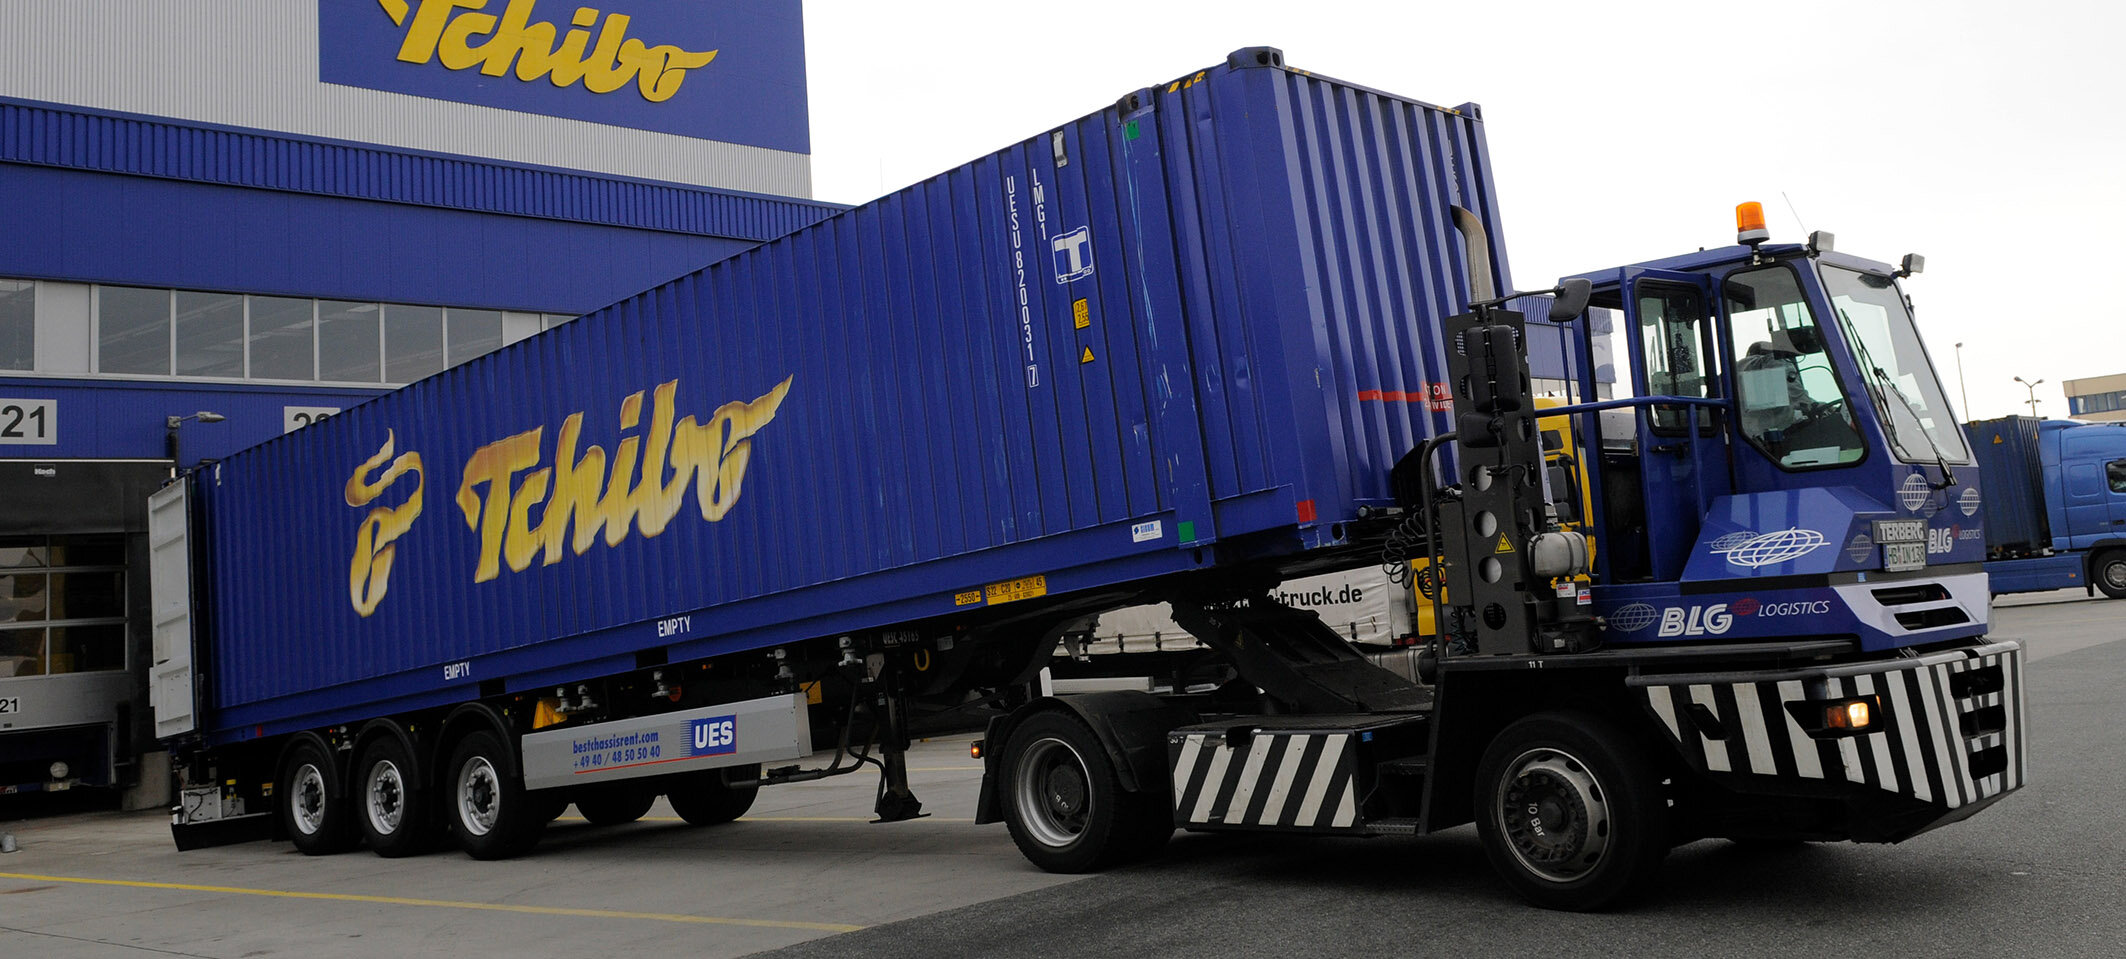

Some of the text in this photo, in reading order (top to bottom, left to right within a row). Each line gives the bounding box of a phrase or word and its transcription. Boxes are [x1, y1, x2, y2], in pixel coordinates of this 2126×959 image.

[378, 0, 718, 103] Tchibo
[1032, 168, 1046, 240] LMG1
[1, 405, 45, 437] 21
[455, 373, 793, 583] Tchibo
[1880, 522, 1924, 540] TERBERG
[1927, 527, 1981, 554] BLG LOGISTICS
[1269, 584, 1363, 606] -truck.de
[658, 615, 691, 637] EMPTY
[1658, 600, 1830, 637] BLG LOGISTICS
[444, 661, 470, 680] EMPTY
[0, 698, 18, 713] 21
[573, 731, 659, 754] bestchassisrent.com
[695, 721, 734, 749] UES
[580, 755, 589, 768] 49
[592, 754, 602, 766] 40
[612, 751, 622, 764] 48
[625, 749, 635, 761] 50
[637, 747, 648, 760] 50
[650, 745, 661, 758] 40
[1527, 802, 1545, 837] 10 Bar
